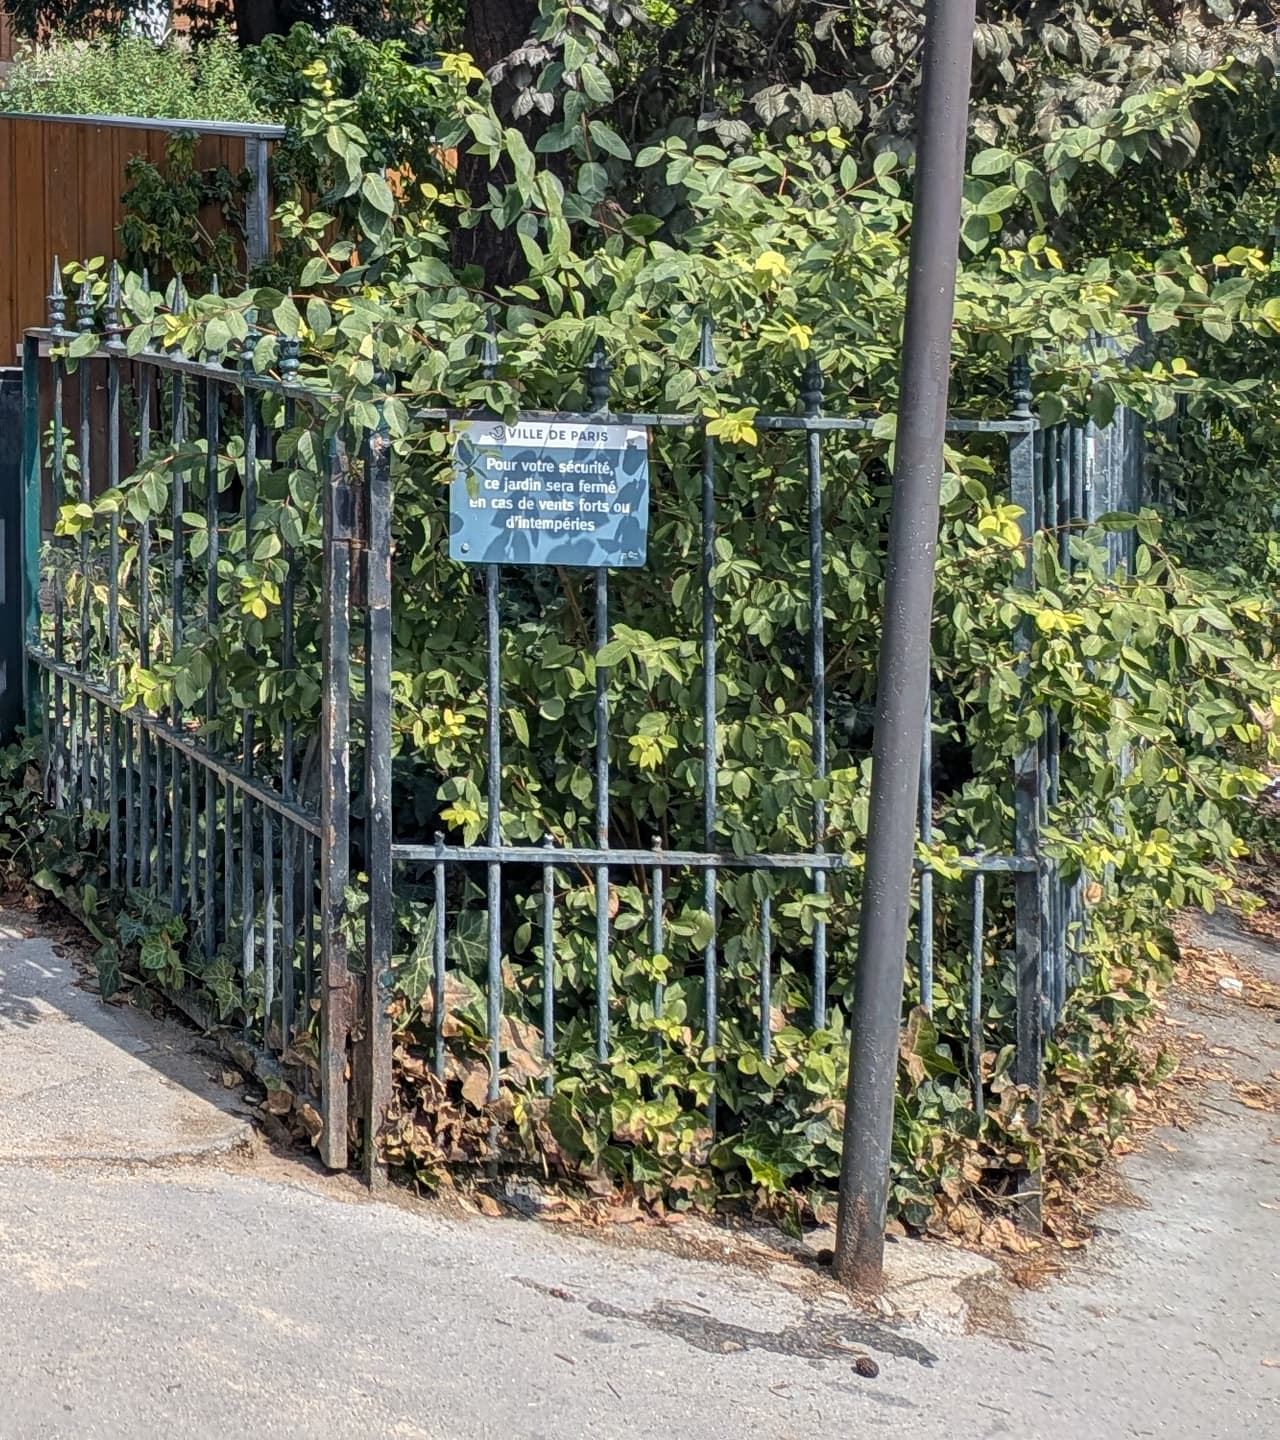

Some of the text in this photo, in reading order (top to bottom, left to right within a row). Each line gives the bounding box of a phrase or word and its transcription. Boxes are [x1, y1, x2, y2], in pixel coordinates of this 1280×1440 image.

[508, 428, 608, 442] VILLE DE PARIS
[486, 458, 614, 476] Pour votre sécurité,
[484, 477, 617, 494] ce jardin sera fermé
[469, 497, 631, 513] en cas de vents forts ou
[506, 516, 595, 532] d'intempéries
